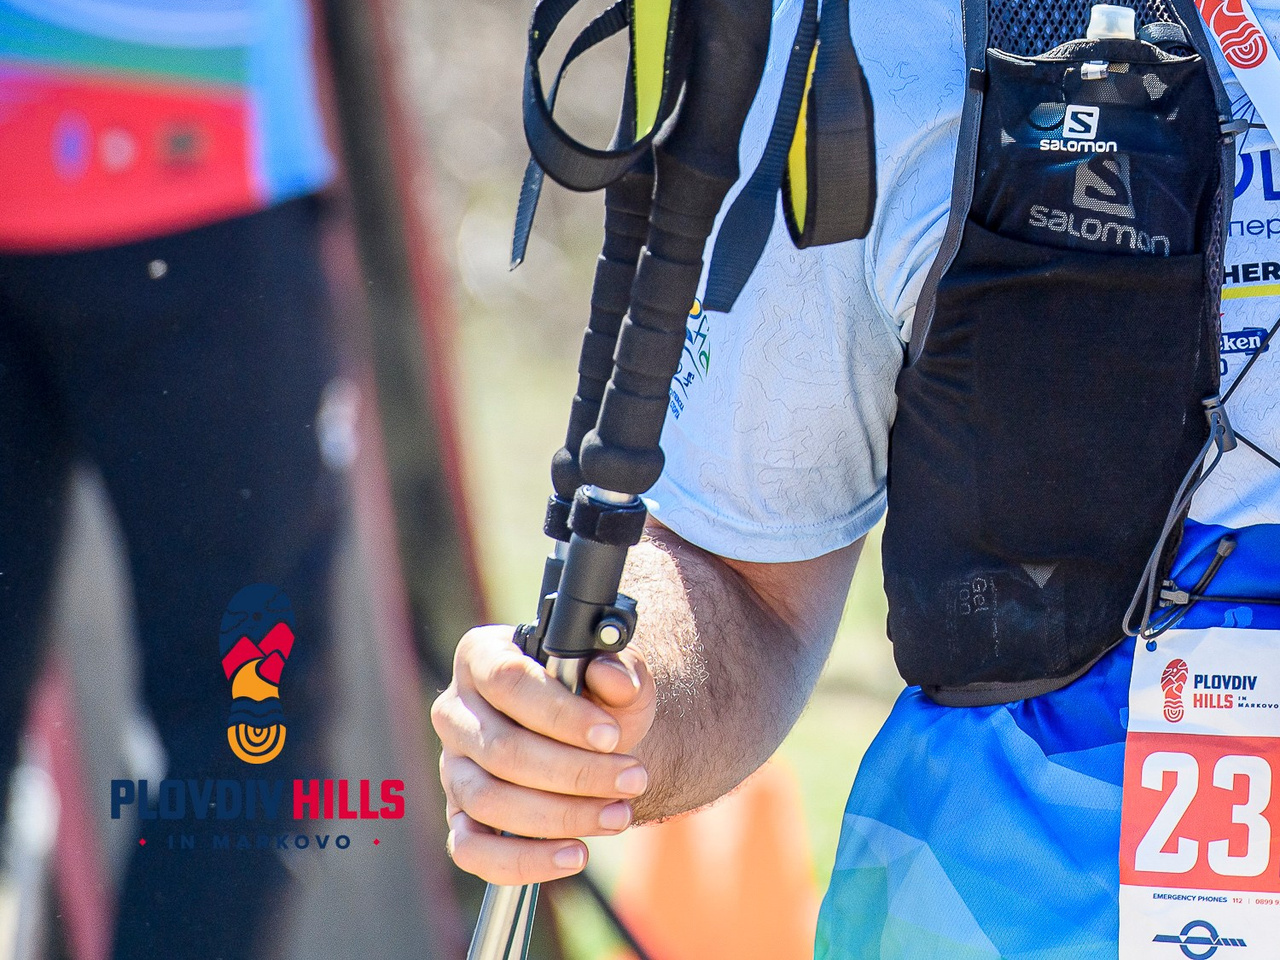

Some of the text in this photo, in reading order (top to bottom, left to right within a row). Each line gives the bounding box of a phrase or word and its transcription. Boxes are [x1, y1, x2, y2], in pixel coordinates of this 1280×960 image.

[1193, 674, 1258, 691] PLOVDIV
[1193, 694, 1234, 709] HILLS
[1152, 892, 1197, 902] EMERGENCY
[1197, 895, 1228, 903] PHONES
